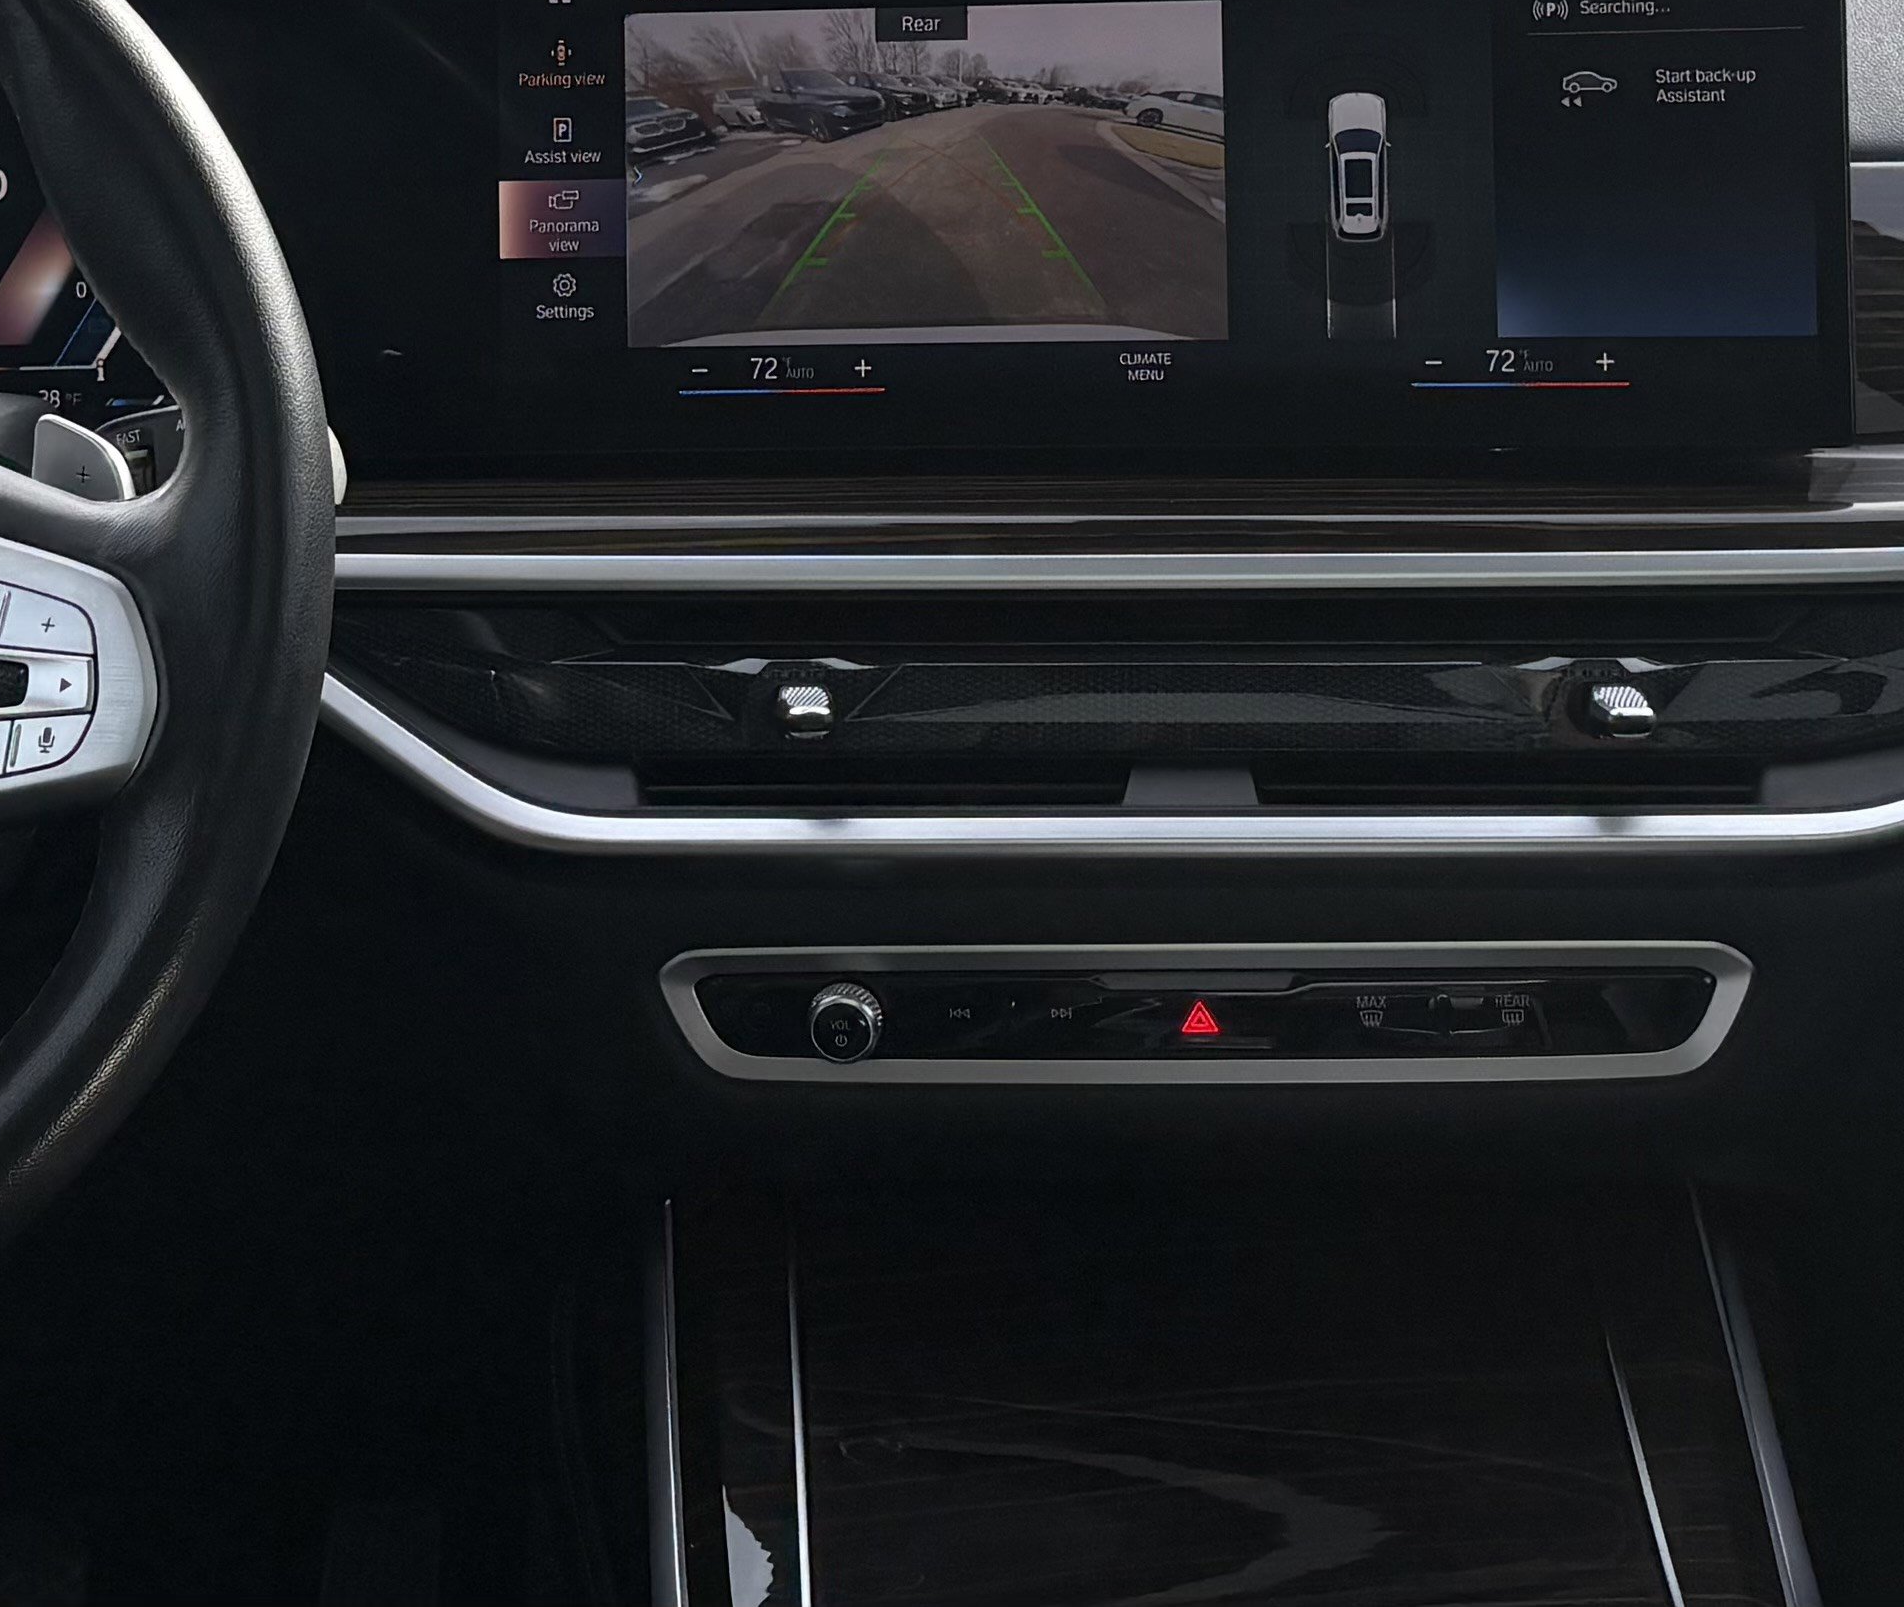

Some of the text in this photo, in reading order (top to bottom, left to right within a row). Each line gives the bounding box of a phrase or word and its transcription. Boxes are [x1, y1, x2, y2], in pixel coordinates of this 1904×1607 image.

[902, 15, 941, 32] Rear
[518, 72, 606, 89] Parking view
[1655, 68, 1691, 84] Start
[1656, 88, 1726, 103] Assistant
[524, 149, 602, 164] Assist view
[529, 219, 600, 234] Panorama
[549, 239, 580, 252] view
[75, 281, 87, 299] 0
[536, 304, 595, 321] Settings
[1119, 353, 1172, 365] CLIMATE
[1486, 349, 1515, 373] 72
[750, 357, 778, 380] 72
[1128, 369, 1164, 381] MENU
[1356, 996, 1386, 1009] MAX
[1496, 994, 1530, 1008] REAR
[831, 1020, 851, 1031] VOL
